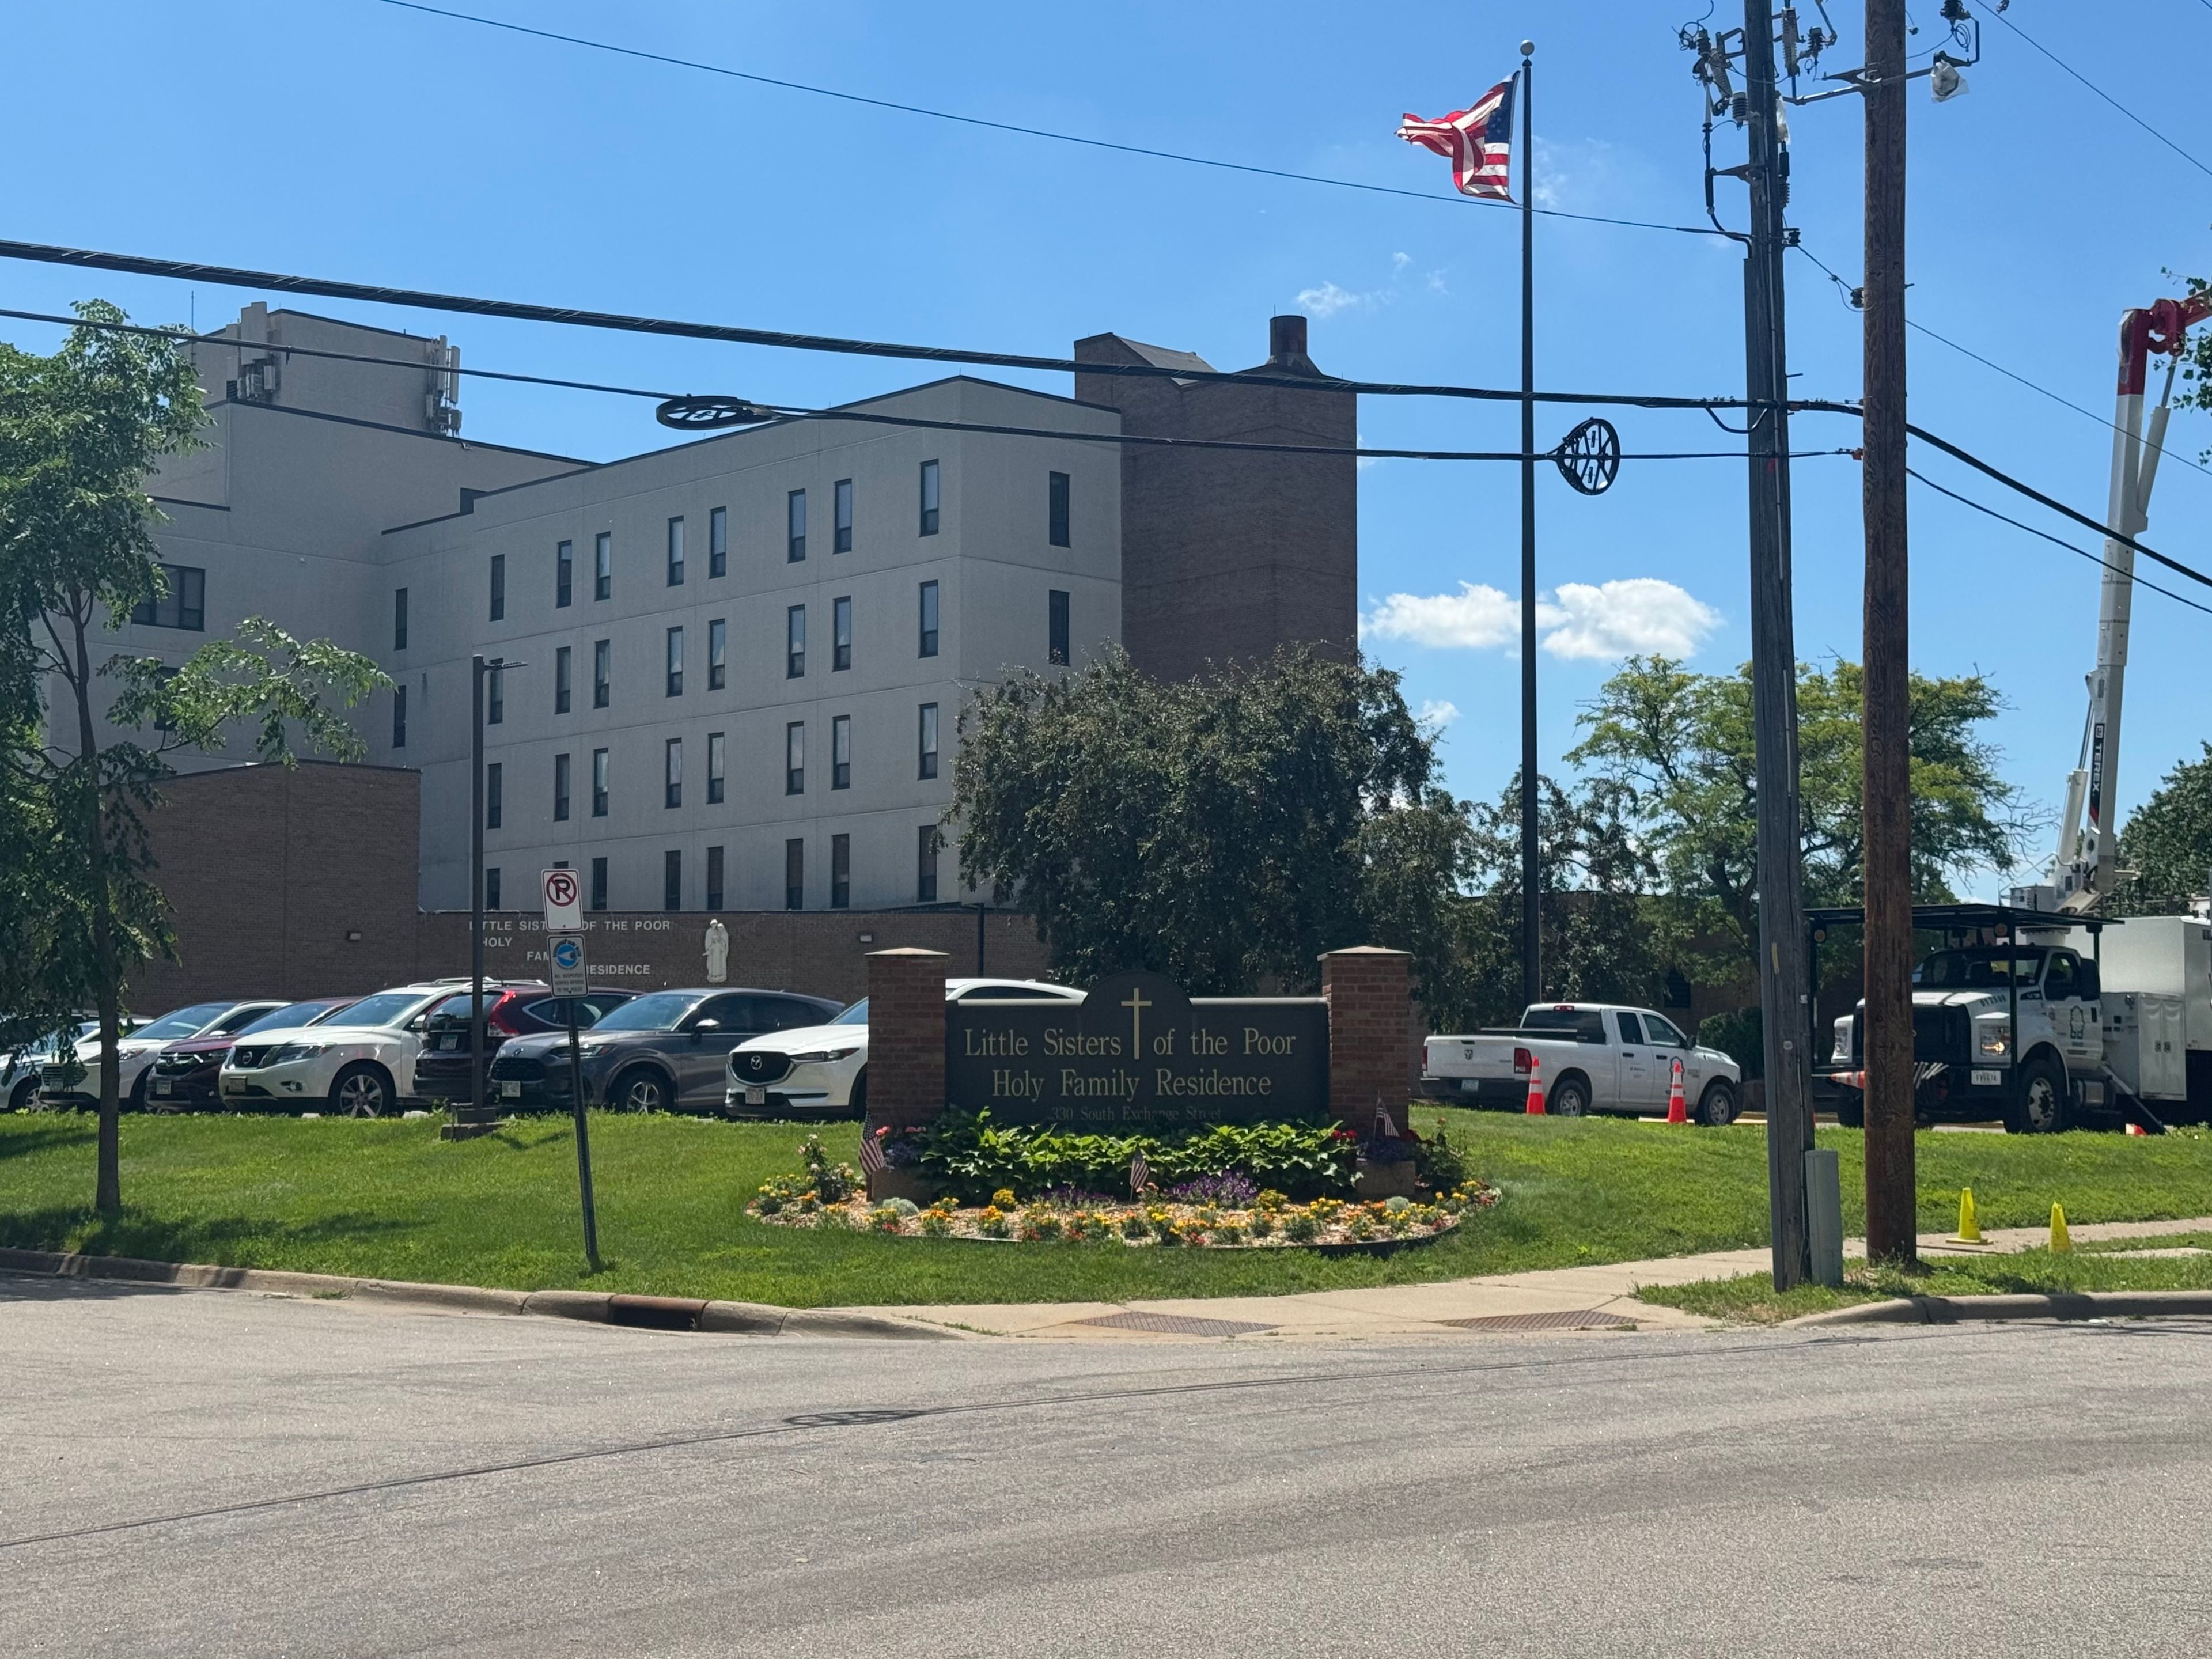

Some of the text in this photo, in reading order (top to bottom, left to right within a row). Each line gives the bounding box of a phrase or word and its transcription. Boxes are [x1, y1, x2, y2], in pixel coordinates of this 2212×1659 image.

[2093, 743, 2102, 792] TEREX
[518, 921, 547, 931] SIST
[604, 921, 628, 931] THE
[635, 921, 671, 931] POOR
[586, 964, 650, 975] ESIDENCE
[964, 1027, 1296, 1056] Little Sisters of the Poor
[992, 1067, 1272, 1103] Holy Family Residence
[1051, 1106, 1073, 1122] 330
[1080, 1106, 1115, 1121] South
